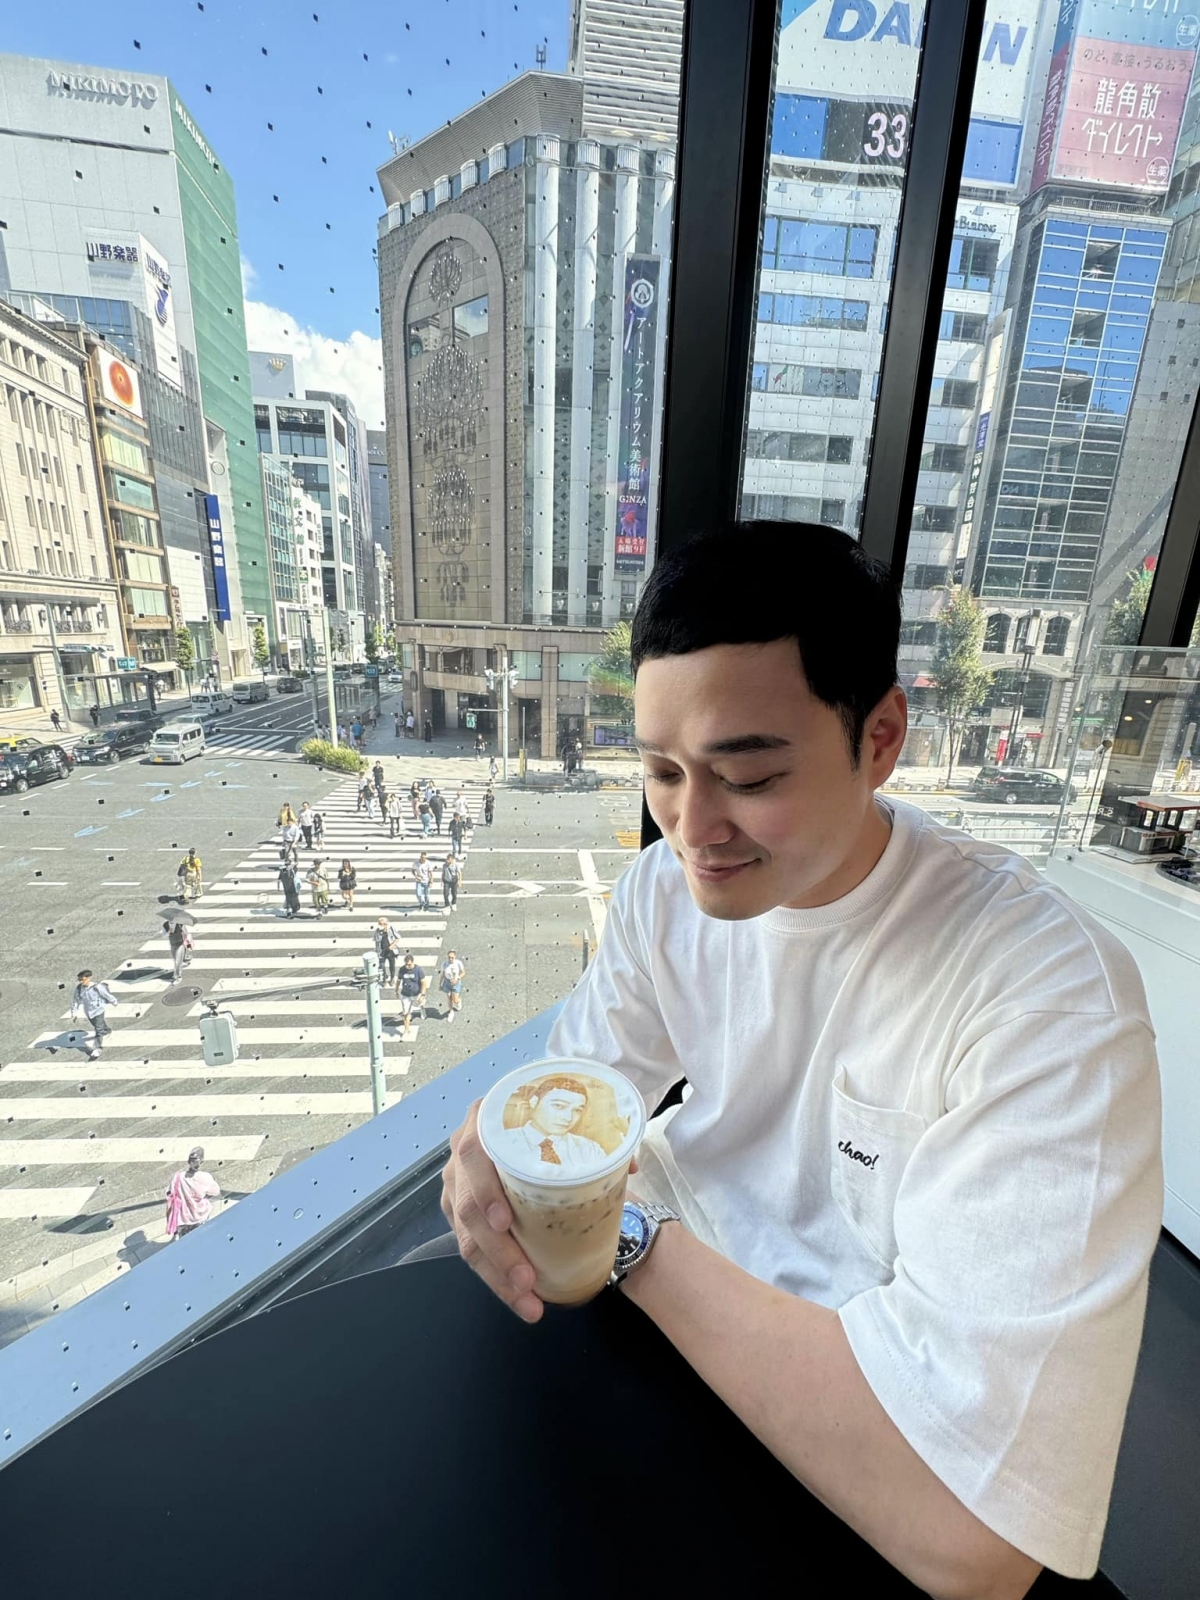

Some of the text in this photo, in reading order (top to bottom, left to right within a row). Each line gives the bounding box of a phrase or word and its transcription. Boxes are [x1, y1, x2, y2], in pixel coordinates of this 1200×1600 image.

[49, 70, 158, 100] MIKIMOTO
[1093, 77, 1162, 119] 龍角散
[863, 112, 907, 158] 33
[86, 242, 138, 262] 山野楽器
[619, 495, 647, 504] GINZA
[838, 1140, 879, 1170] chao!
